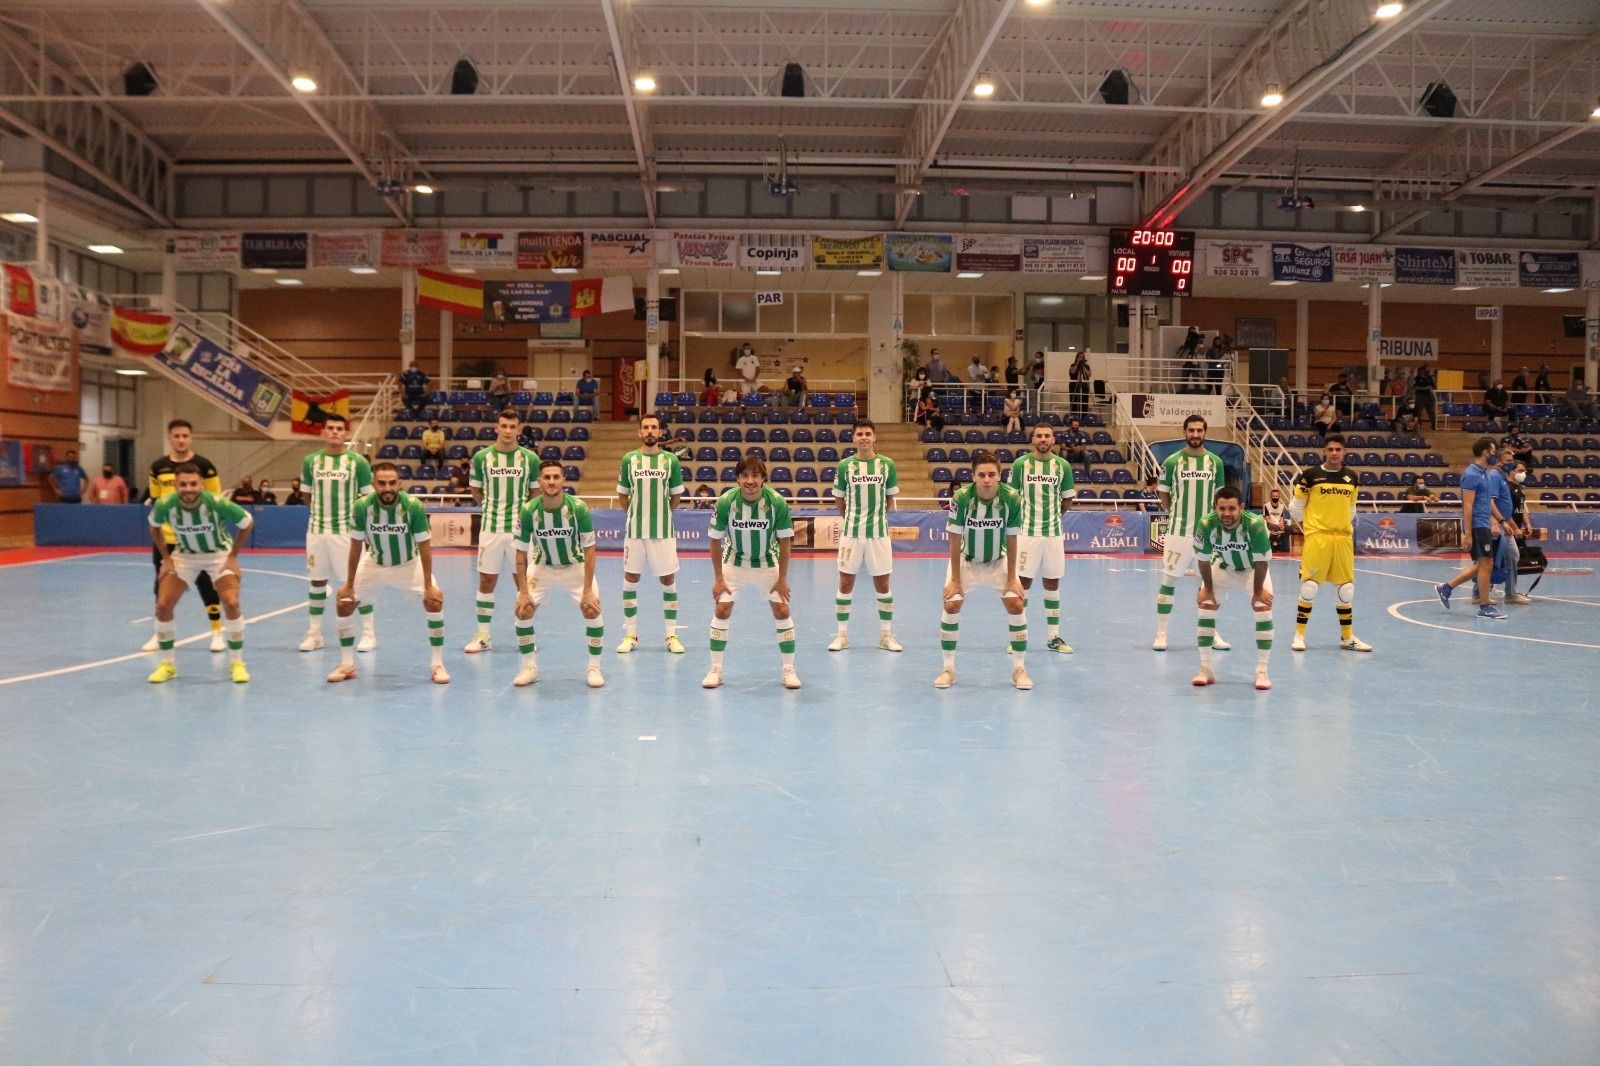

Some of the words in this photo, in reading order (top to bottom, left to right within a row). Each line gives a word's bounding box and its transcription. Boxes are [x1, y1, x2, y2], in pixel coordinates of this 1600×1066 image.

[591, 233, 647, 242] PASCUAL
[674, 232, 706, 240] Patatas
[1132, 231, 1174, 245] 20:00
[546, 246, 579, 267] Sur
[747, 247, 799, 260] Copinja
[1222, 247, 1254, 263] SPC
[1335, 252, 1357, 263] CASA
[1360, 252, 1382, 265] JUAN
[1469, 252, 1512, 264] TOBAR
[1117, 257, 1137, 271] 00
[1172, 259, 1191, 273] 00
[1294, 257, 1331, 266] SEGUROS
[1281, 265, 1311, 275] Allianz
[1116, 276, 1124, 287] 0
[1178, 278, 1186, 289] 0
[757, 292, 782, 304] PAR
[1477, 309, 1499, 318] IMPAR
[1380, 339, 1434, 357] RIBUNA
[1159, 407, 1213, 416] Valdepeñas
[315, 470, 348, 480] betway
[490, 467, 522, 477] betway
[633, 469, 666, 479] betway
[1181, 470, 1211, 480] betway
[851, 474, 883, 484] betway
[1026, 474, 1057, 484] betway
[1320, 486, 1352, 498] betway
[369, 523, 407, 534] betway
[732, 519, 769, 530] betway
[967, 518, 1003, 529] betway
[536, 527, 573, 539] betway
[597, 530, 620, 539] cer
[929, 528, 949, 541] Un
[1556, 529, 1574, 541] Un
[1580, 529, 1600, 541] Pla
[1091, 536, 1139, 548] ALBALI
[1364, 537, 1410, 549] ALBALI
[1020, 551, 1028, 565] 5
[1168, 551, 1182, 565] 77
